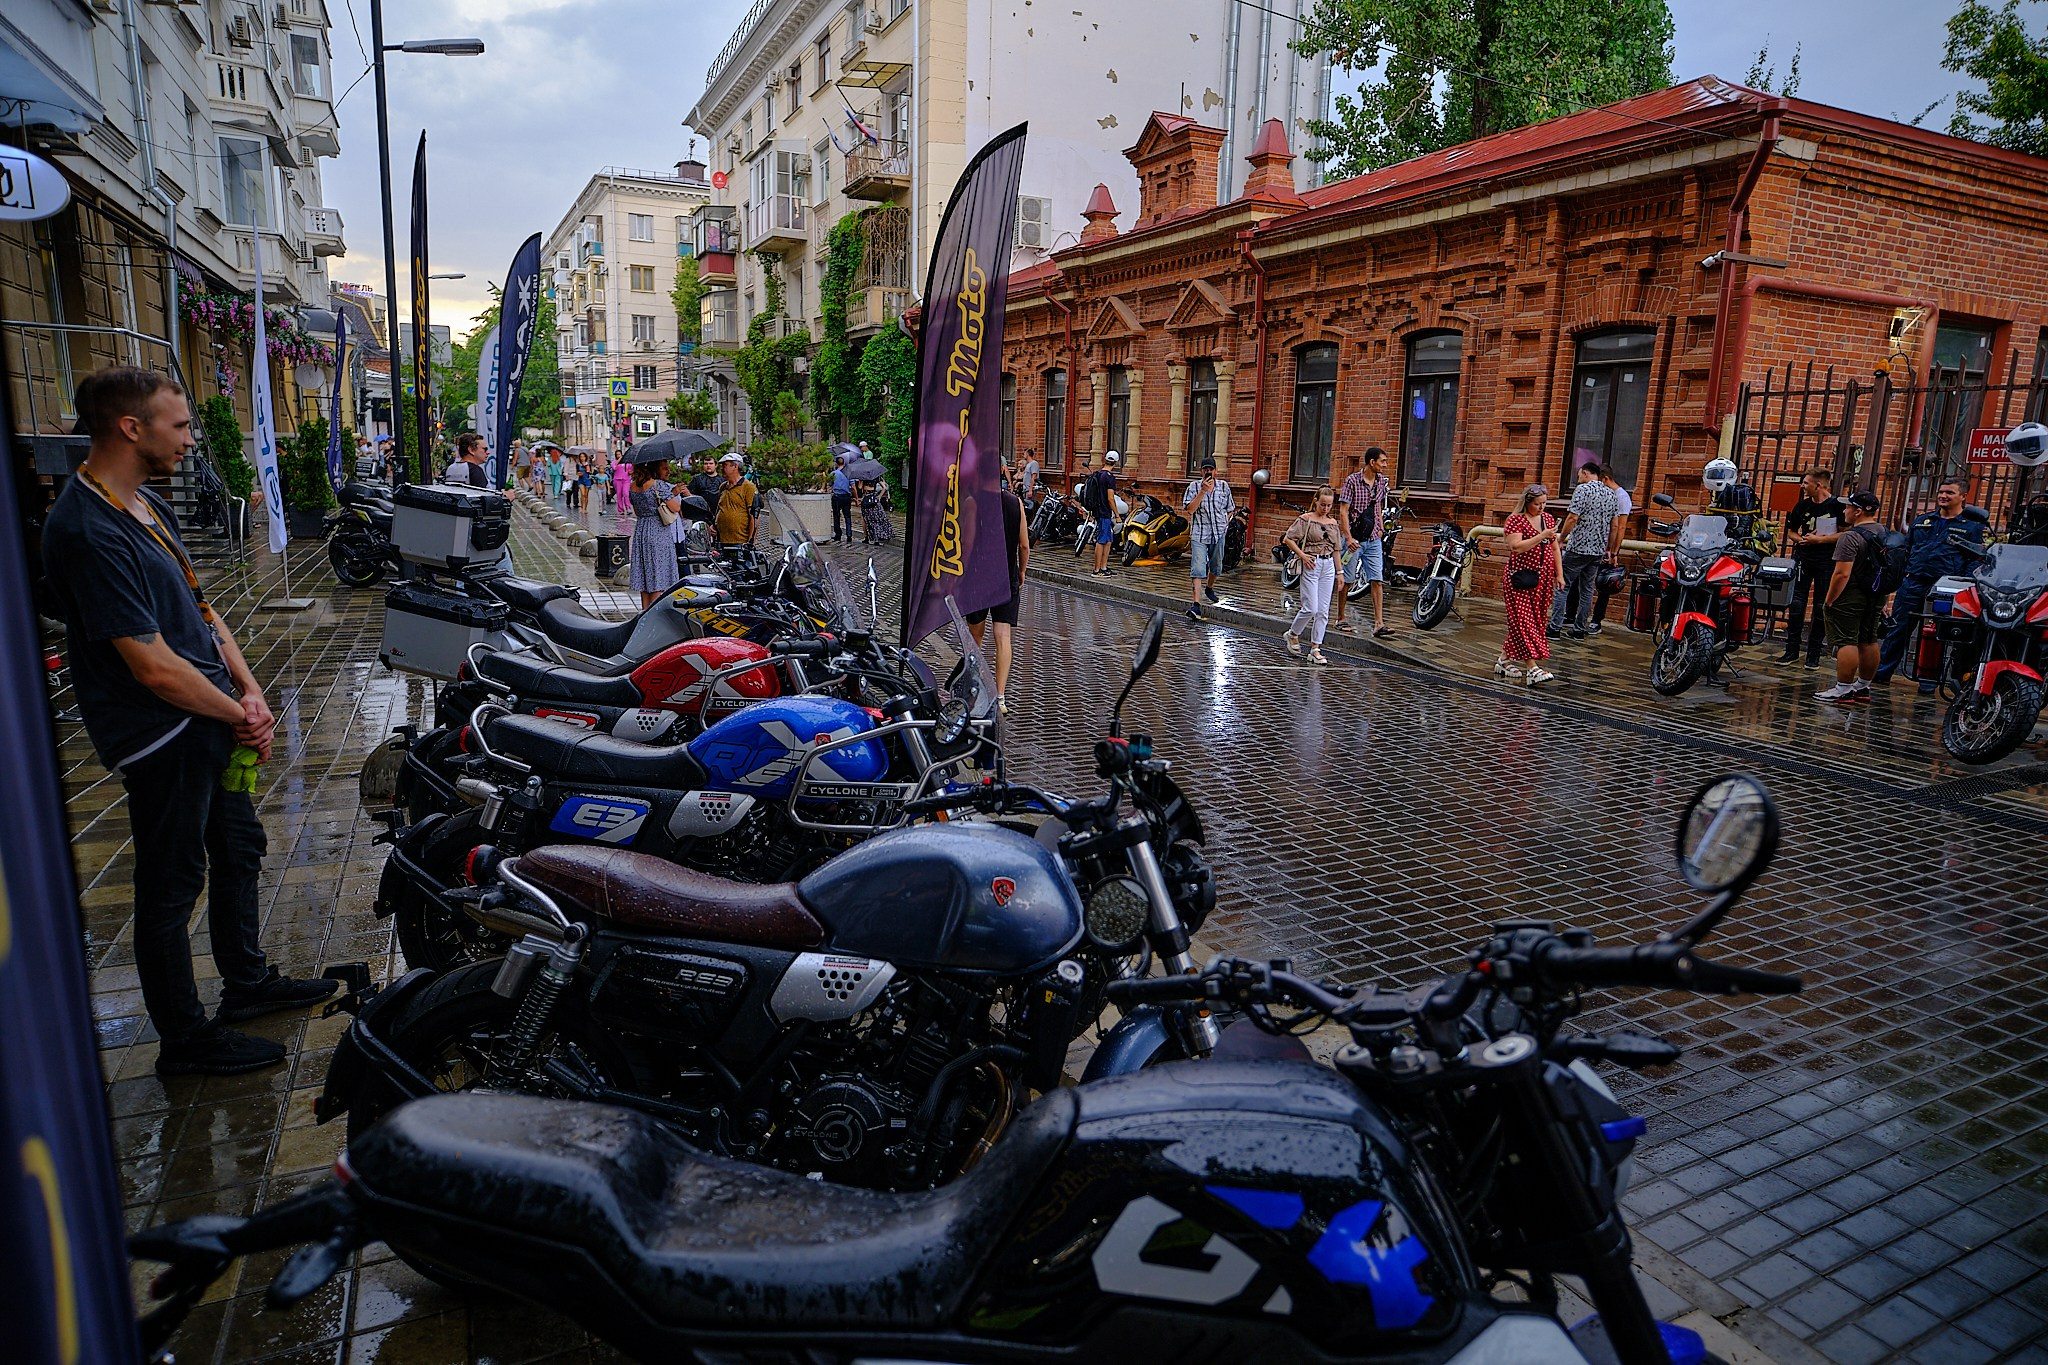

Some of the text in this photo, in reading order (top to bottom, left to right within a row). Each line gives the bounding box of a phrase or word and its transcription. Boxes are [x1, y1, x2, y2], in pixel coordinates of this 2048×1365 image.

[946, 247, 987, 396] Moto
[1972, 447, 2011, 458] НЕ СТ
[701, 720, 857, 788] REX
[810, 786, 868, 796] CYCLONE
[674, 968, 734, 987] RE3
[793, 1129, 839, 1138] CYCLONE
